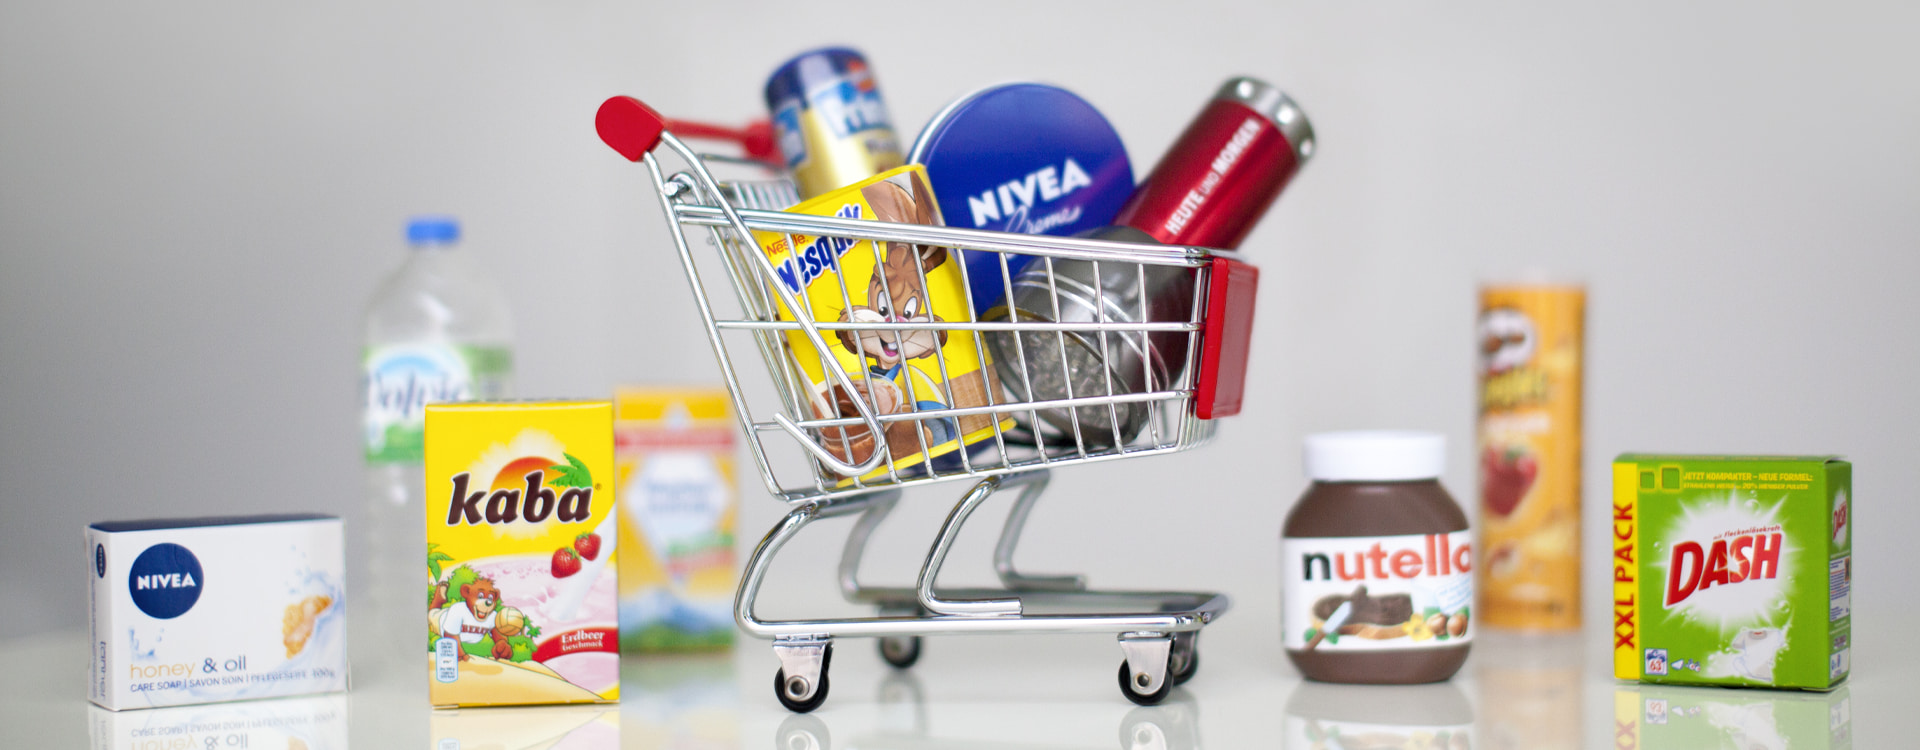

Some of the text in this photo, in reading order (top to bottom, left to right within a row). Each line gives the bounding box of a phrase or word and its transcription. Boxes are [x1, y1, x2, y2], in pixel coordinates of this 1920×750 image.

[1165, 118, 1260, 235] HEUTE UND MORGEN
[968, 158, 1092, 227] NIVEA
[766, 233, 806, 257] Neslé
[1683, 472, 1705, 480] JETZT
[1706, 472, 1752, 481] KOMPAKTER
[1759, 473, 1778, 481] NEUE
[447, 469, 593, 525] kaba
[1832, 500, 1847, 541] DASH
[137, 572, 197, 590] NIVEA
[1613, 502, 1635, 650] XXL PACK
[1665, 533, 1783, 607] DASH
[561, 630, 605, 643] Erdbeer
[562, 640, 603, 651] Geschmack
[130, 655, 247, 680] honey & oil
[1650, 659, 1662, 672] 63
[130, 682, 155, 692] CARE
[157, 680, 182, 690] SOAP
[189, 677, 220, 688] SAVON
[222, 675, 244, 686] SOIN
